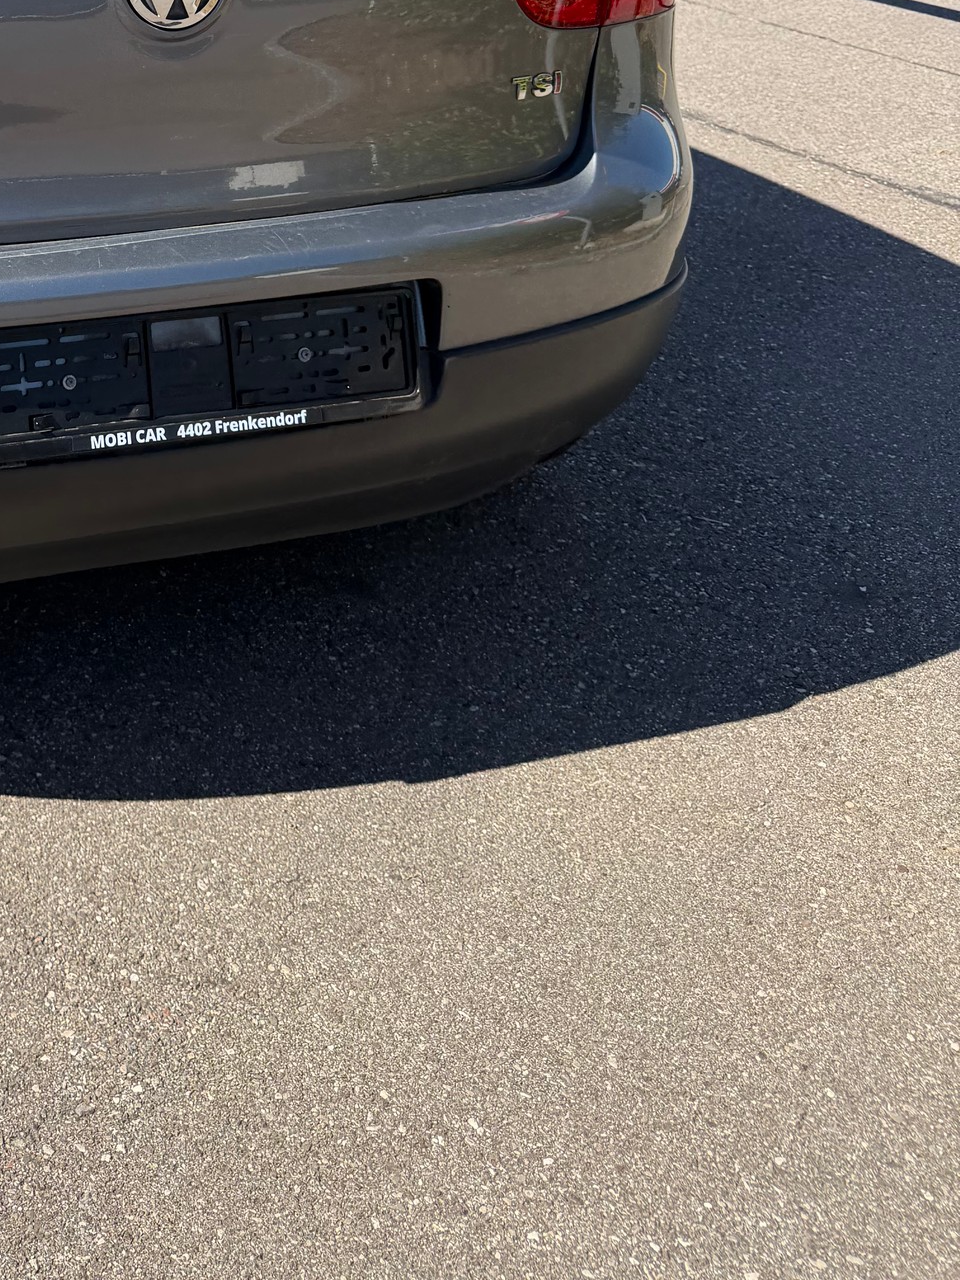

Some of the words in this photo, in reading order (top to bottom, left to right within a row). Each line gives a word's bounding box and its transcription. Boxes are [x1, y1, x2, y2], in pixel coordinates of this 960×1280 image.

[511, 70, 562, 100] TSI
[90, 431, 132, 450] MOBI
[136, 427, 167, 443] CAR
[177, 421, 212, 438] 4402
[215, 410, 308, 434] Frenkendorf
